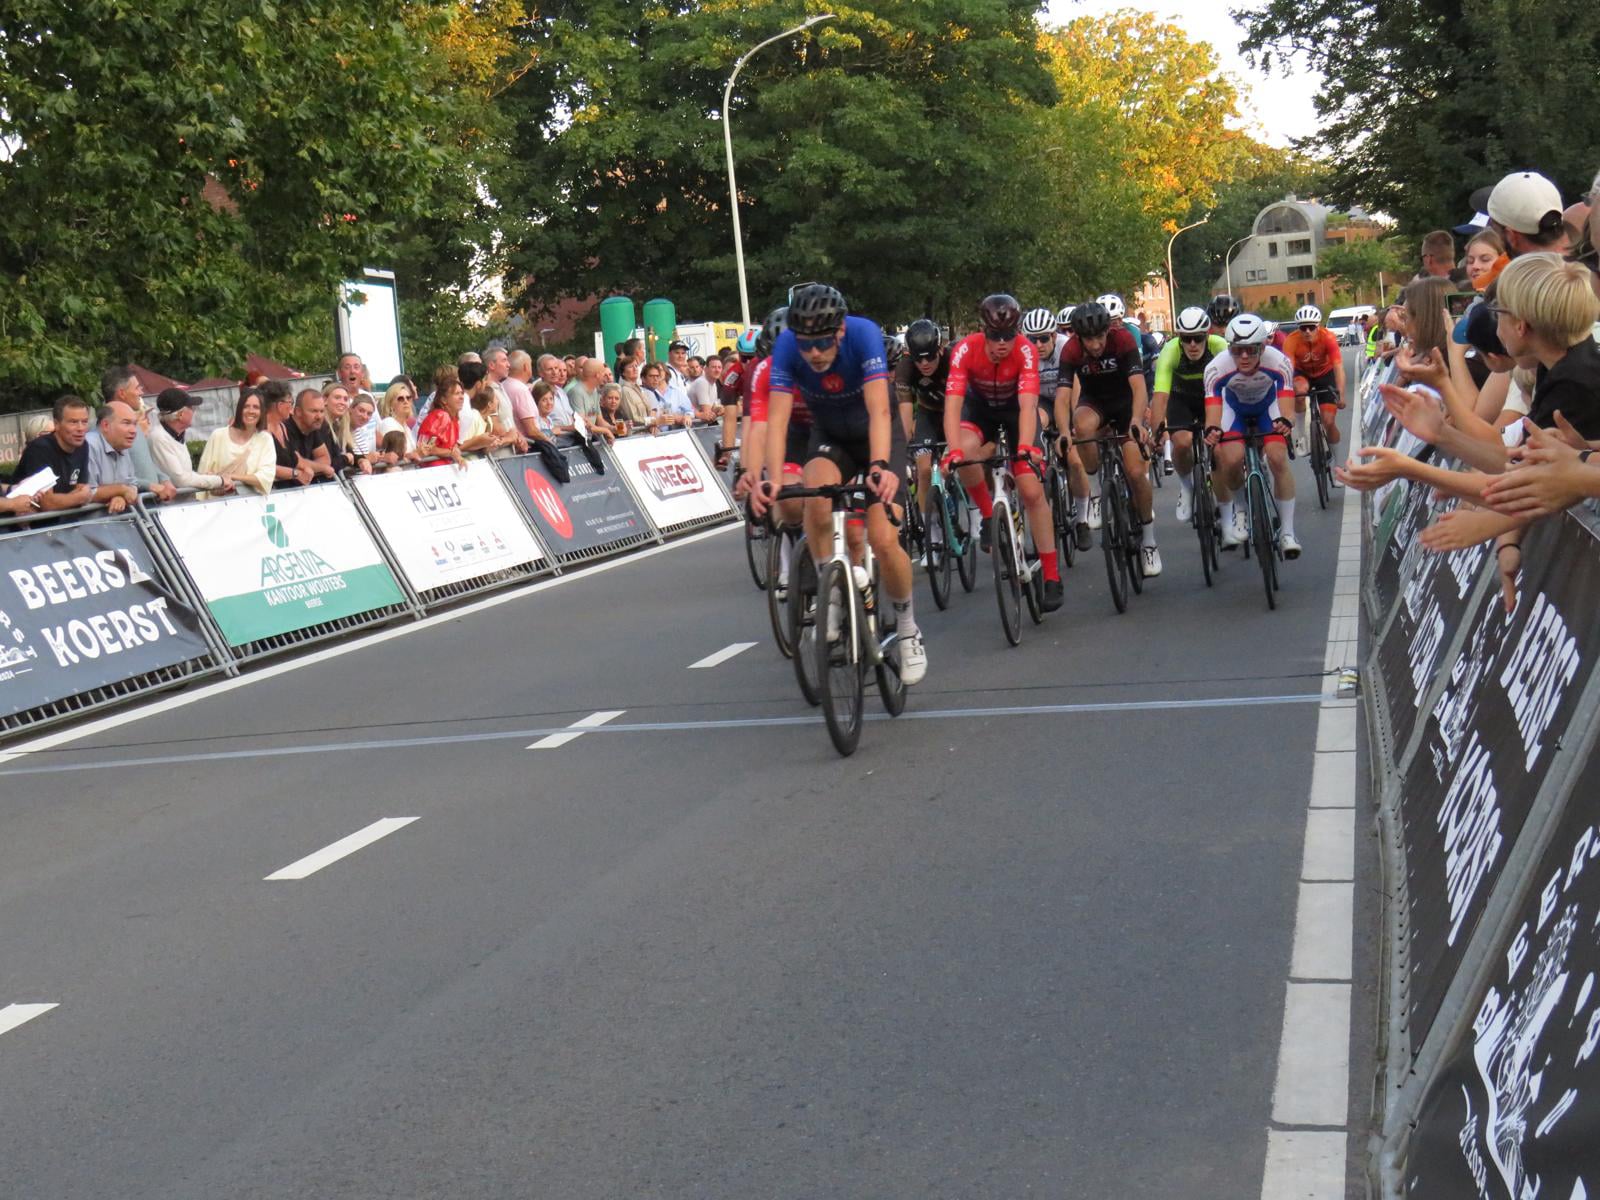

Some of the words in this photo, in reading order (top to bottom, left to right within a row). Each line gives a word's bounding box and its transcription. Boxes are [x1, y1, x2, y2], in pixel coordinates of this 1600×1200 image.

[260, 548, 336, 587] ARGENTA
[263, 582, 310, 607] KANTOOR
[304, 574, 347, 596] WOUTERS
[40, 596, 178, 667] KOERST
[1436, 729, 1503, 947] KOERST
